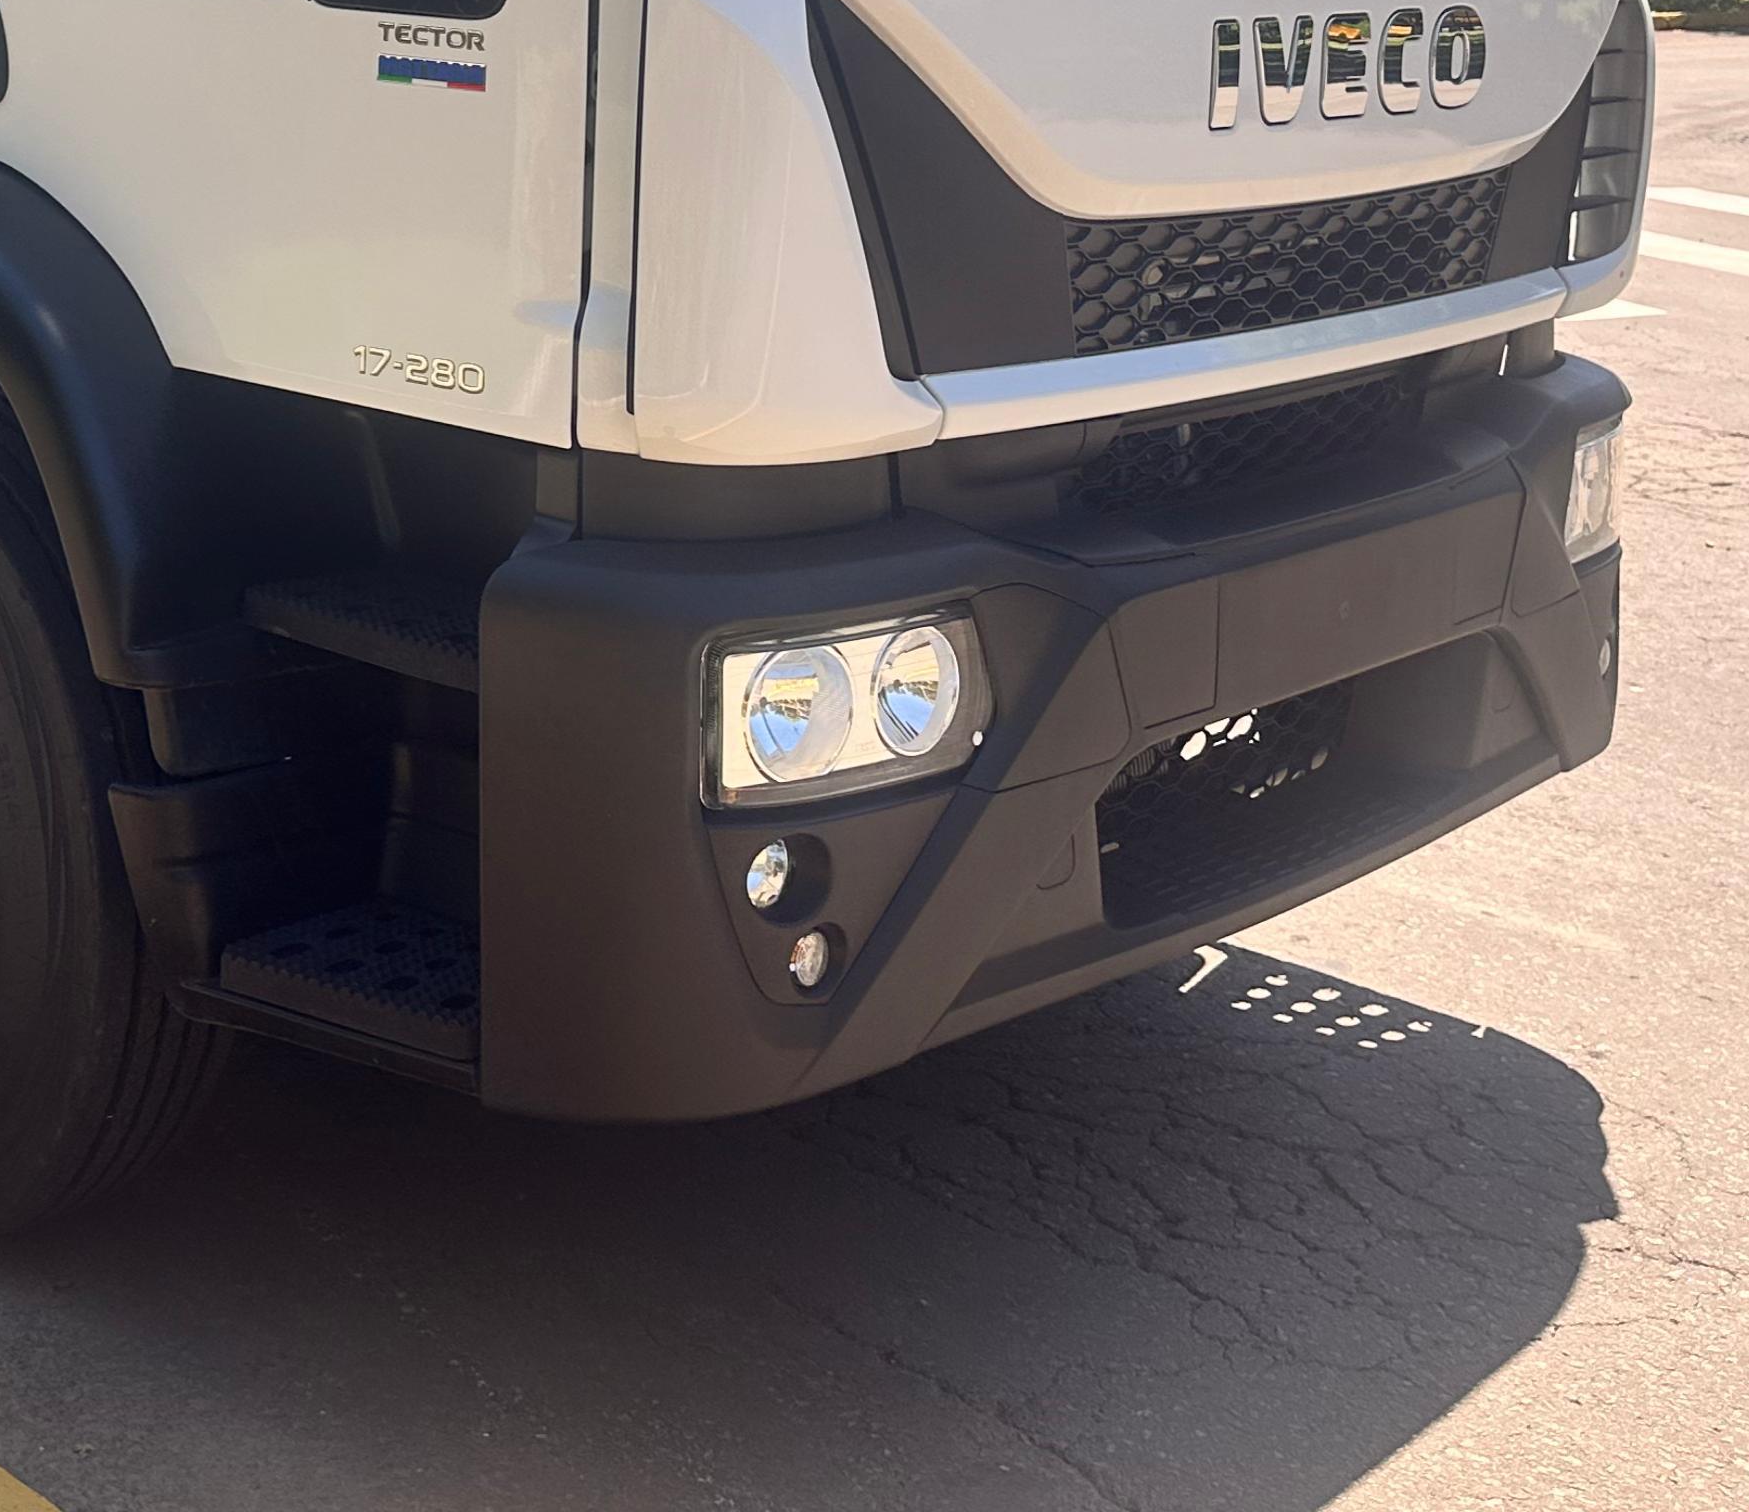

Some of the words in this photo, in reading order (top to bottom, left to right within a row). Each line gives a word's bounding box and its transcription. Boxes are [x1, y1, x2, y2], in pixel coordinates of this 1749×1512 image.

[377, 21, 486, 52] TECTOR
[1207, 2, 1488, 132] IVECO
[353, 345, 486, 395] 17-280
